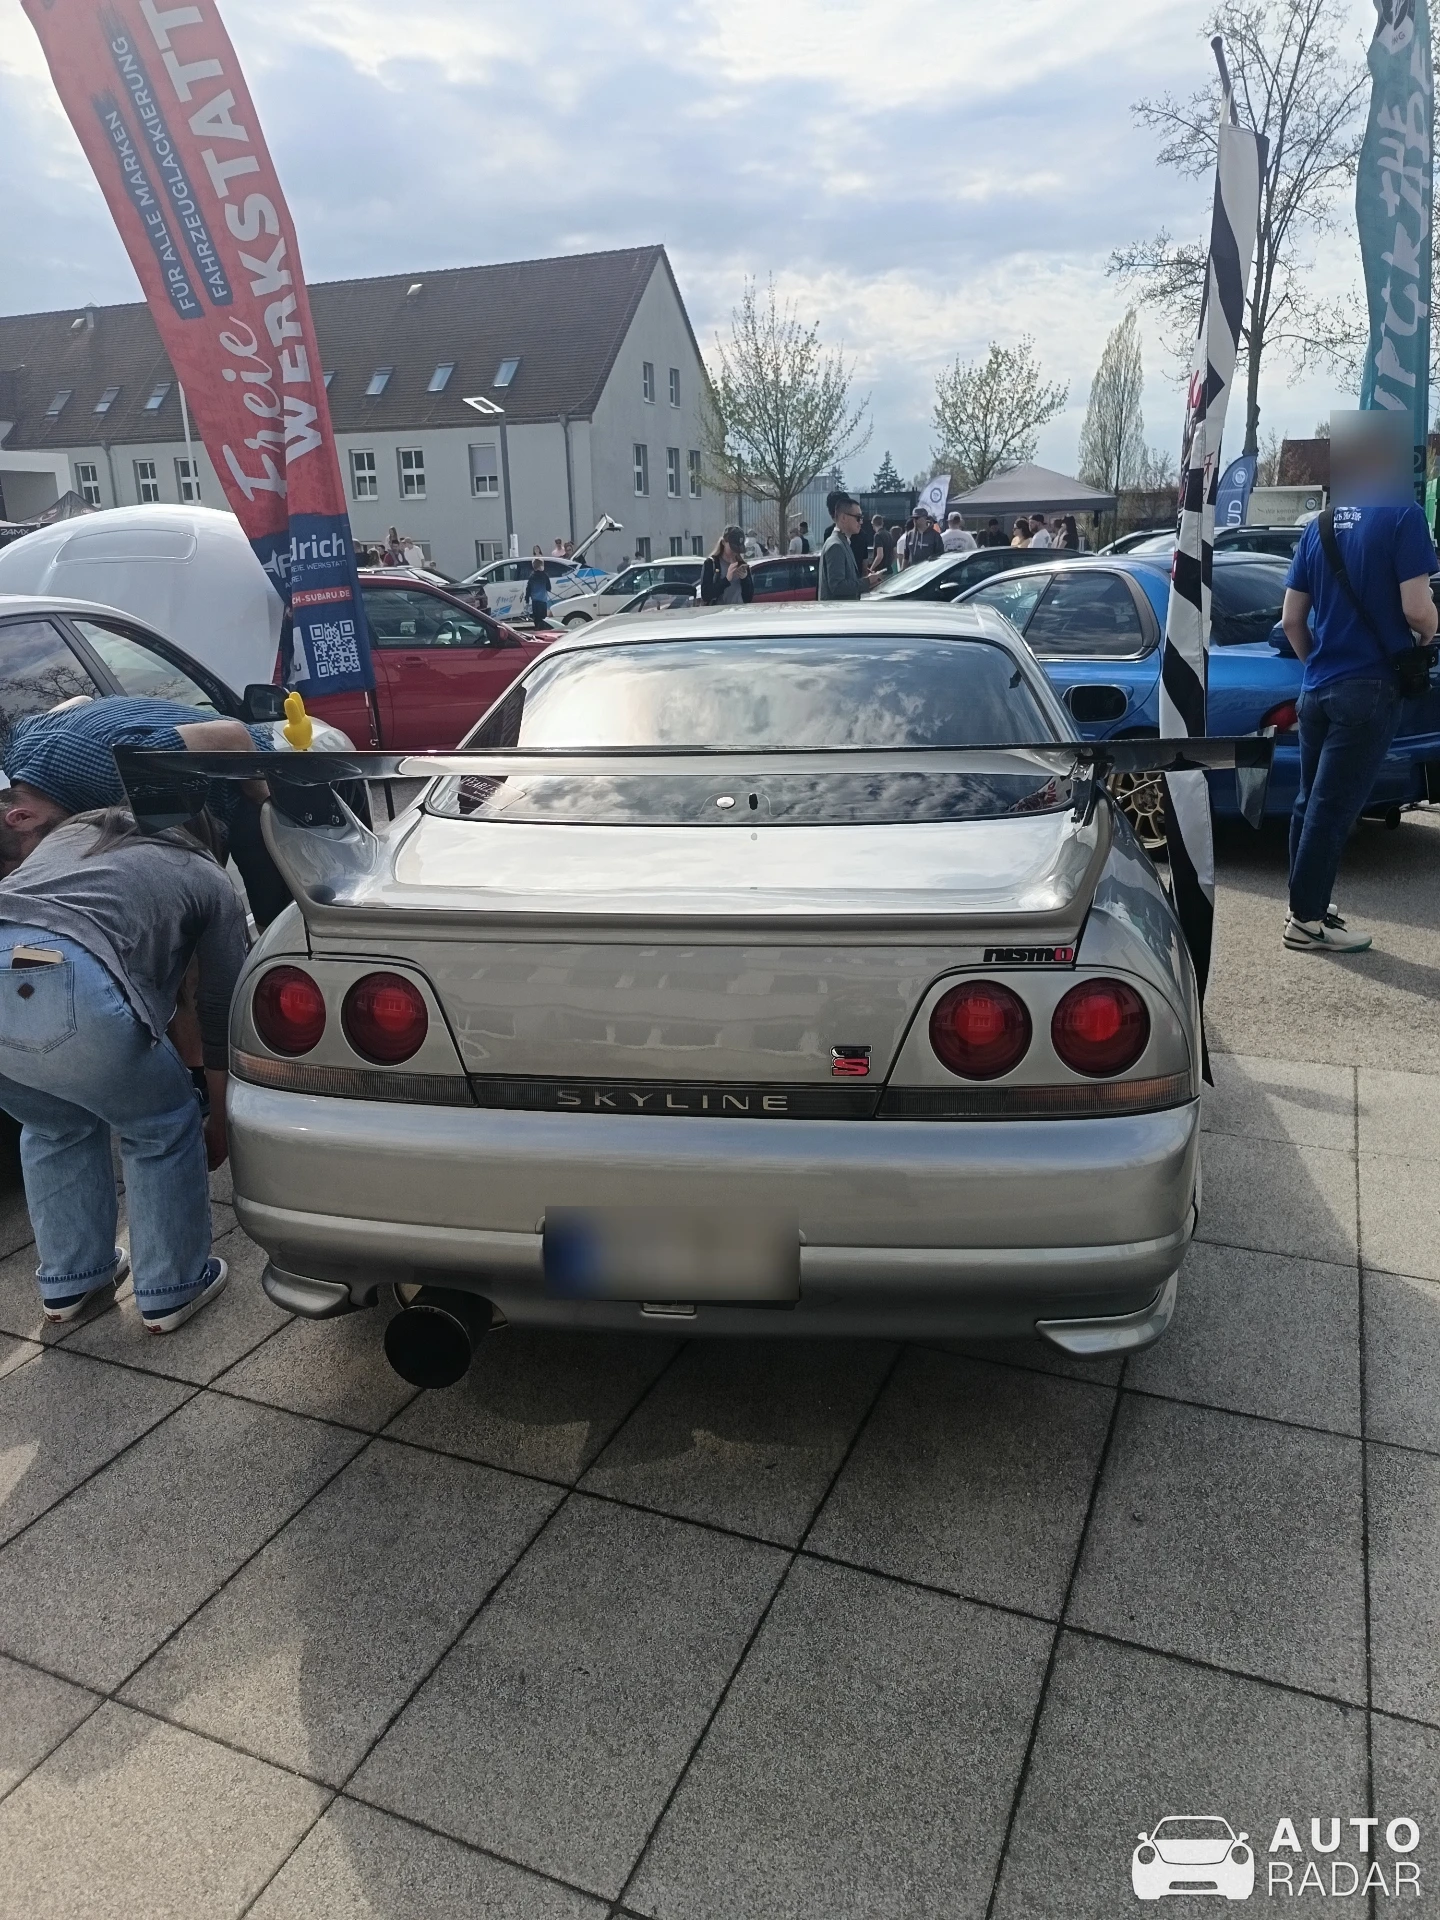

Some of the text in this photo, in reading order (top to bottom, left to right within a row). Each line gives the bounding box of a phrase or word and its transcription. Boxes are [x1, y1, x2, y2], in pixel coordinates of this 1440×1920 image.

[105, 110, 196, 311] FÜR ALLE MARKEN
[112, 37, 228, 299] FAHRZEUGLACKIERUNG
[139, 0, 323, 464] WERKSTATT
[1227, 500, 1242, 526] ÜD
[292, 590, 350, 605] CH-SUBARU.DE
[557, 1090, 788, 1111] SKYLINE
